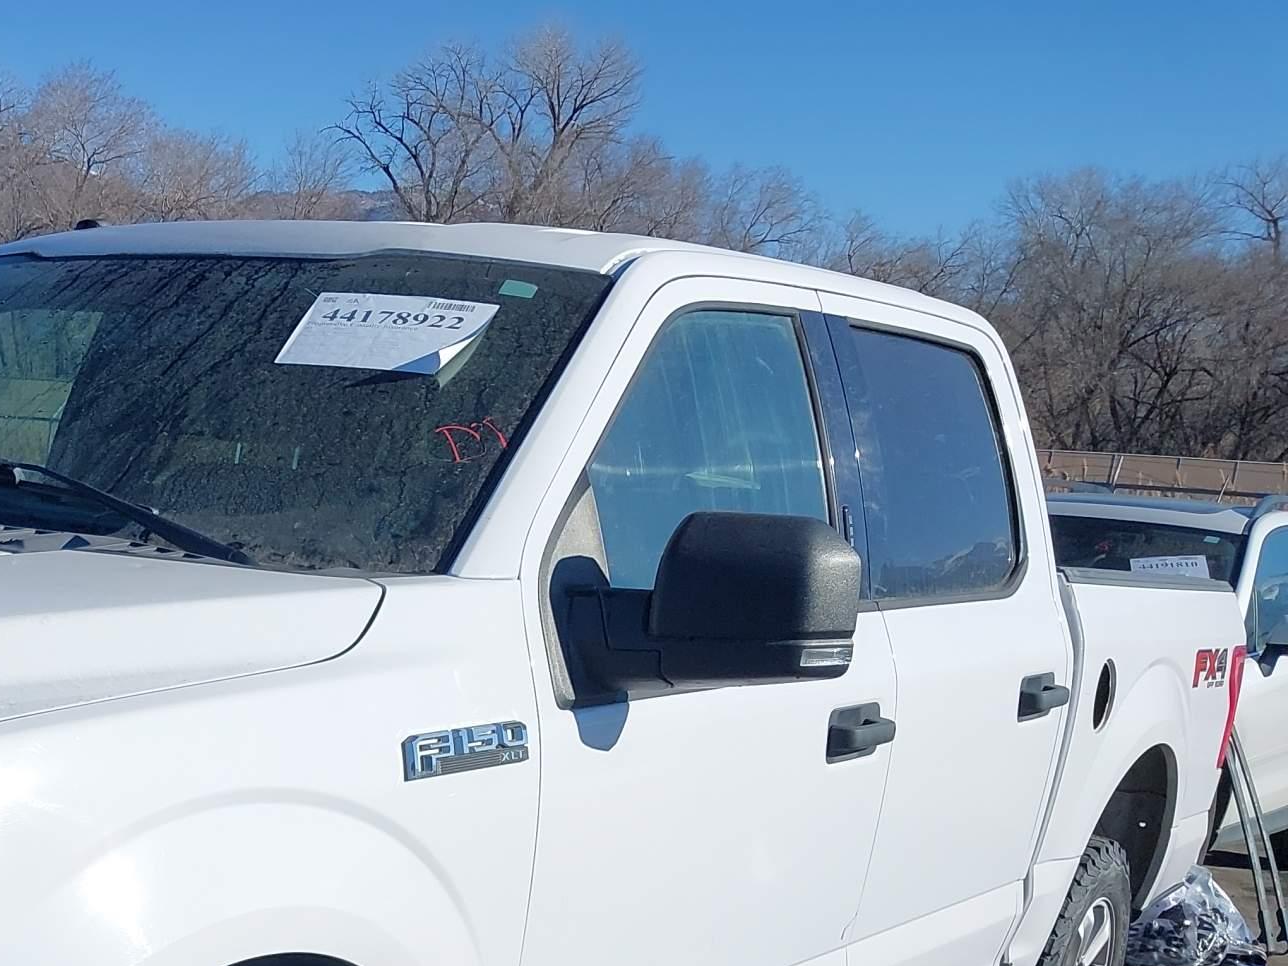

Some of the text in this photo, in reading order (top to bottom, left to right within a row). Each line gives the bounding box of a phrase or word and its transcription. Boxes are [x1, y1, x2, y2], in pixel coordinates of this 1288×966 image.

[321, 307, 465, 330] 44178922
[1192, 648, 1228, 688] FX4
[500, 750, 525, 762] XLT
